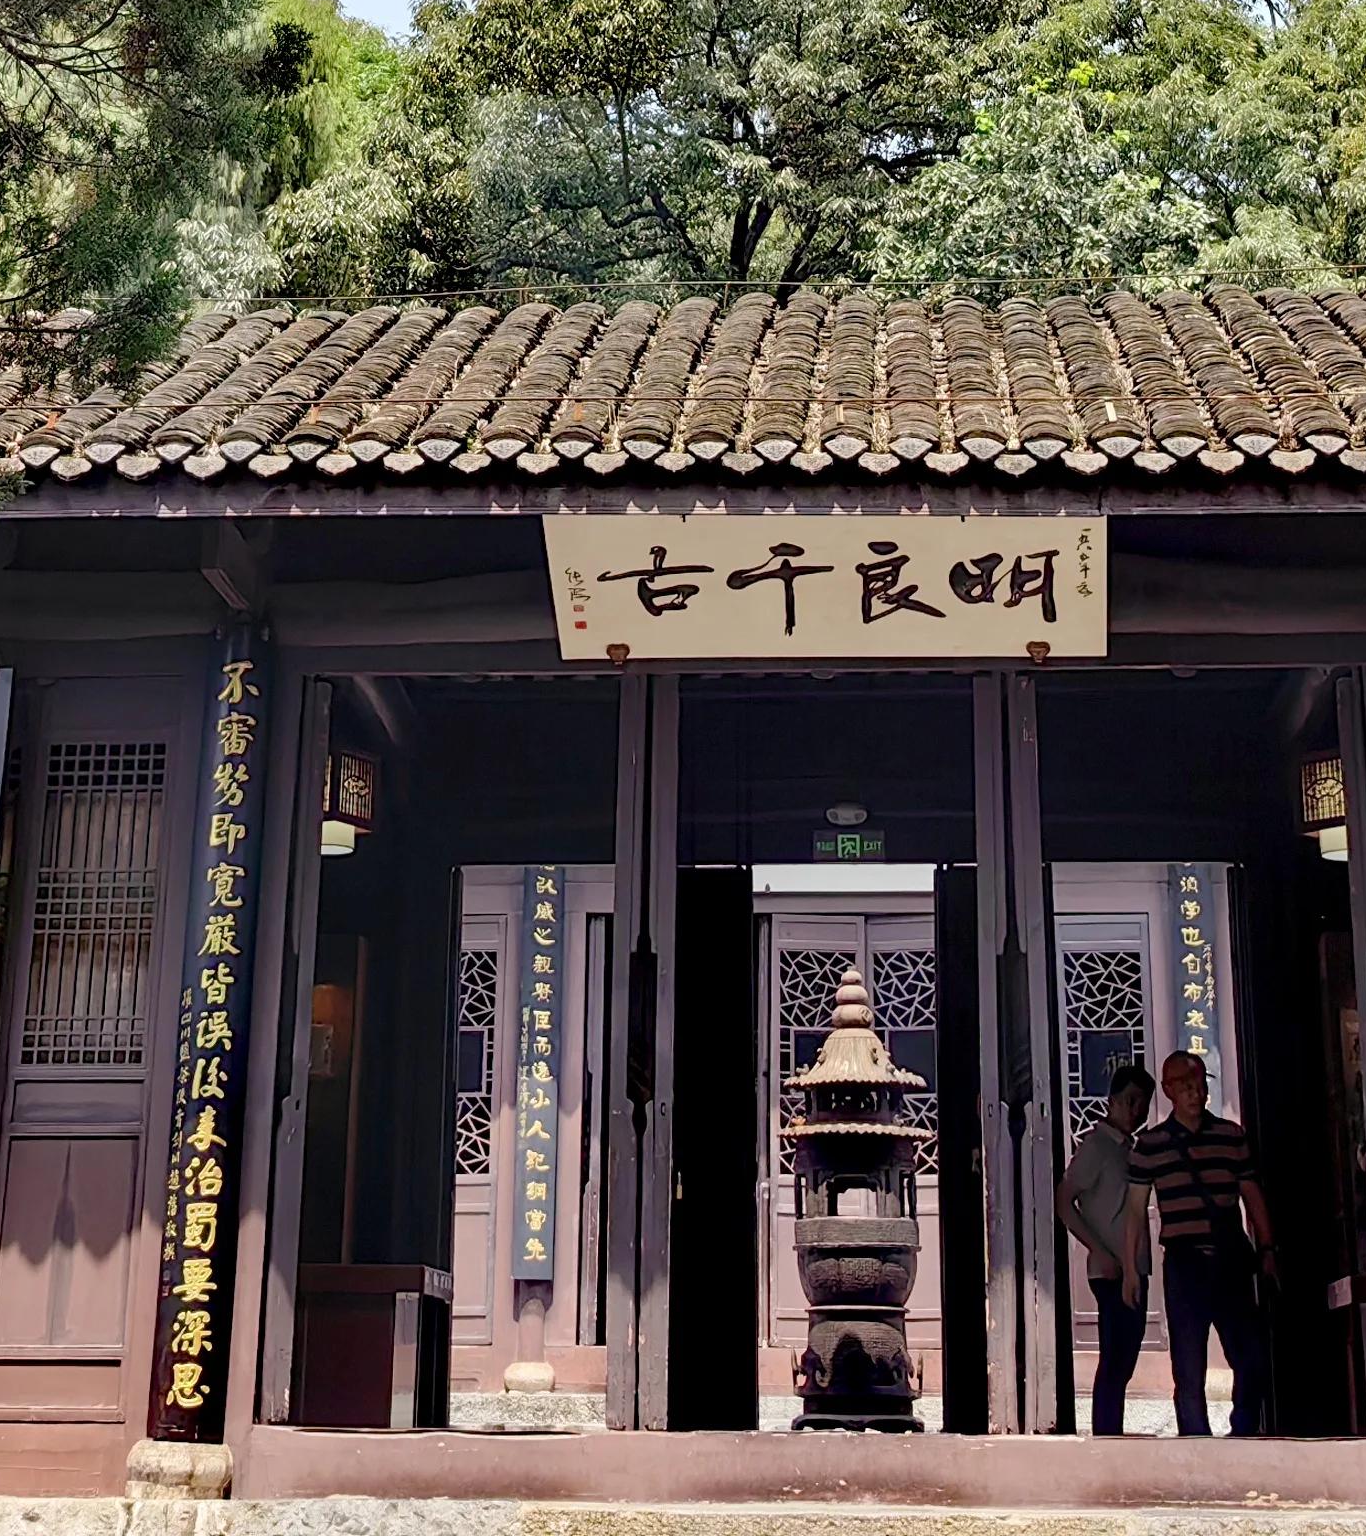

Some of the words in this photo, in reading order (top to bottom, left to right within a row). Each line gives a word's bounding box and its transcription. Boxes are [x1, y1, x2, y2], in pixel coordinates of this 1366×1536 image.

[597, 541, 1060, 636] 明良千古
[863, 841, 882, 851] EXIT
